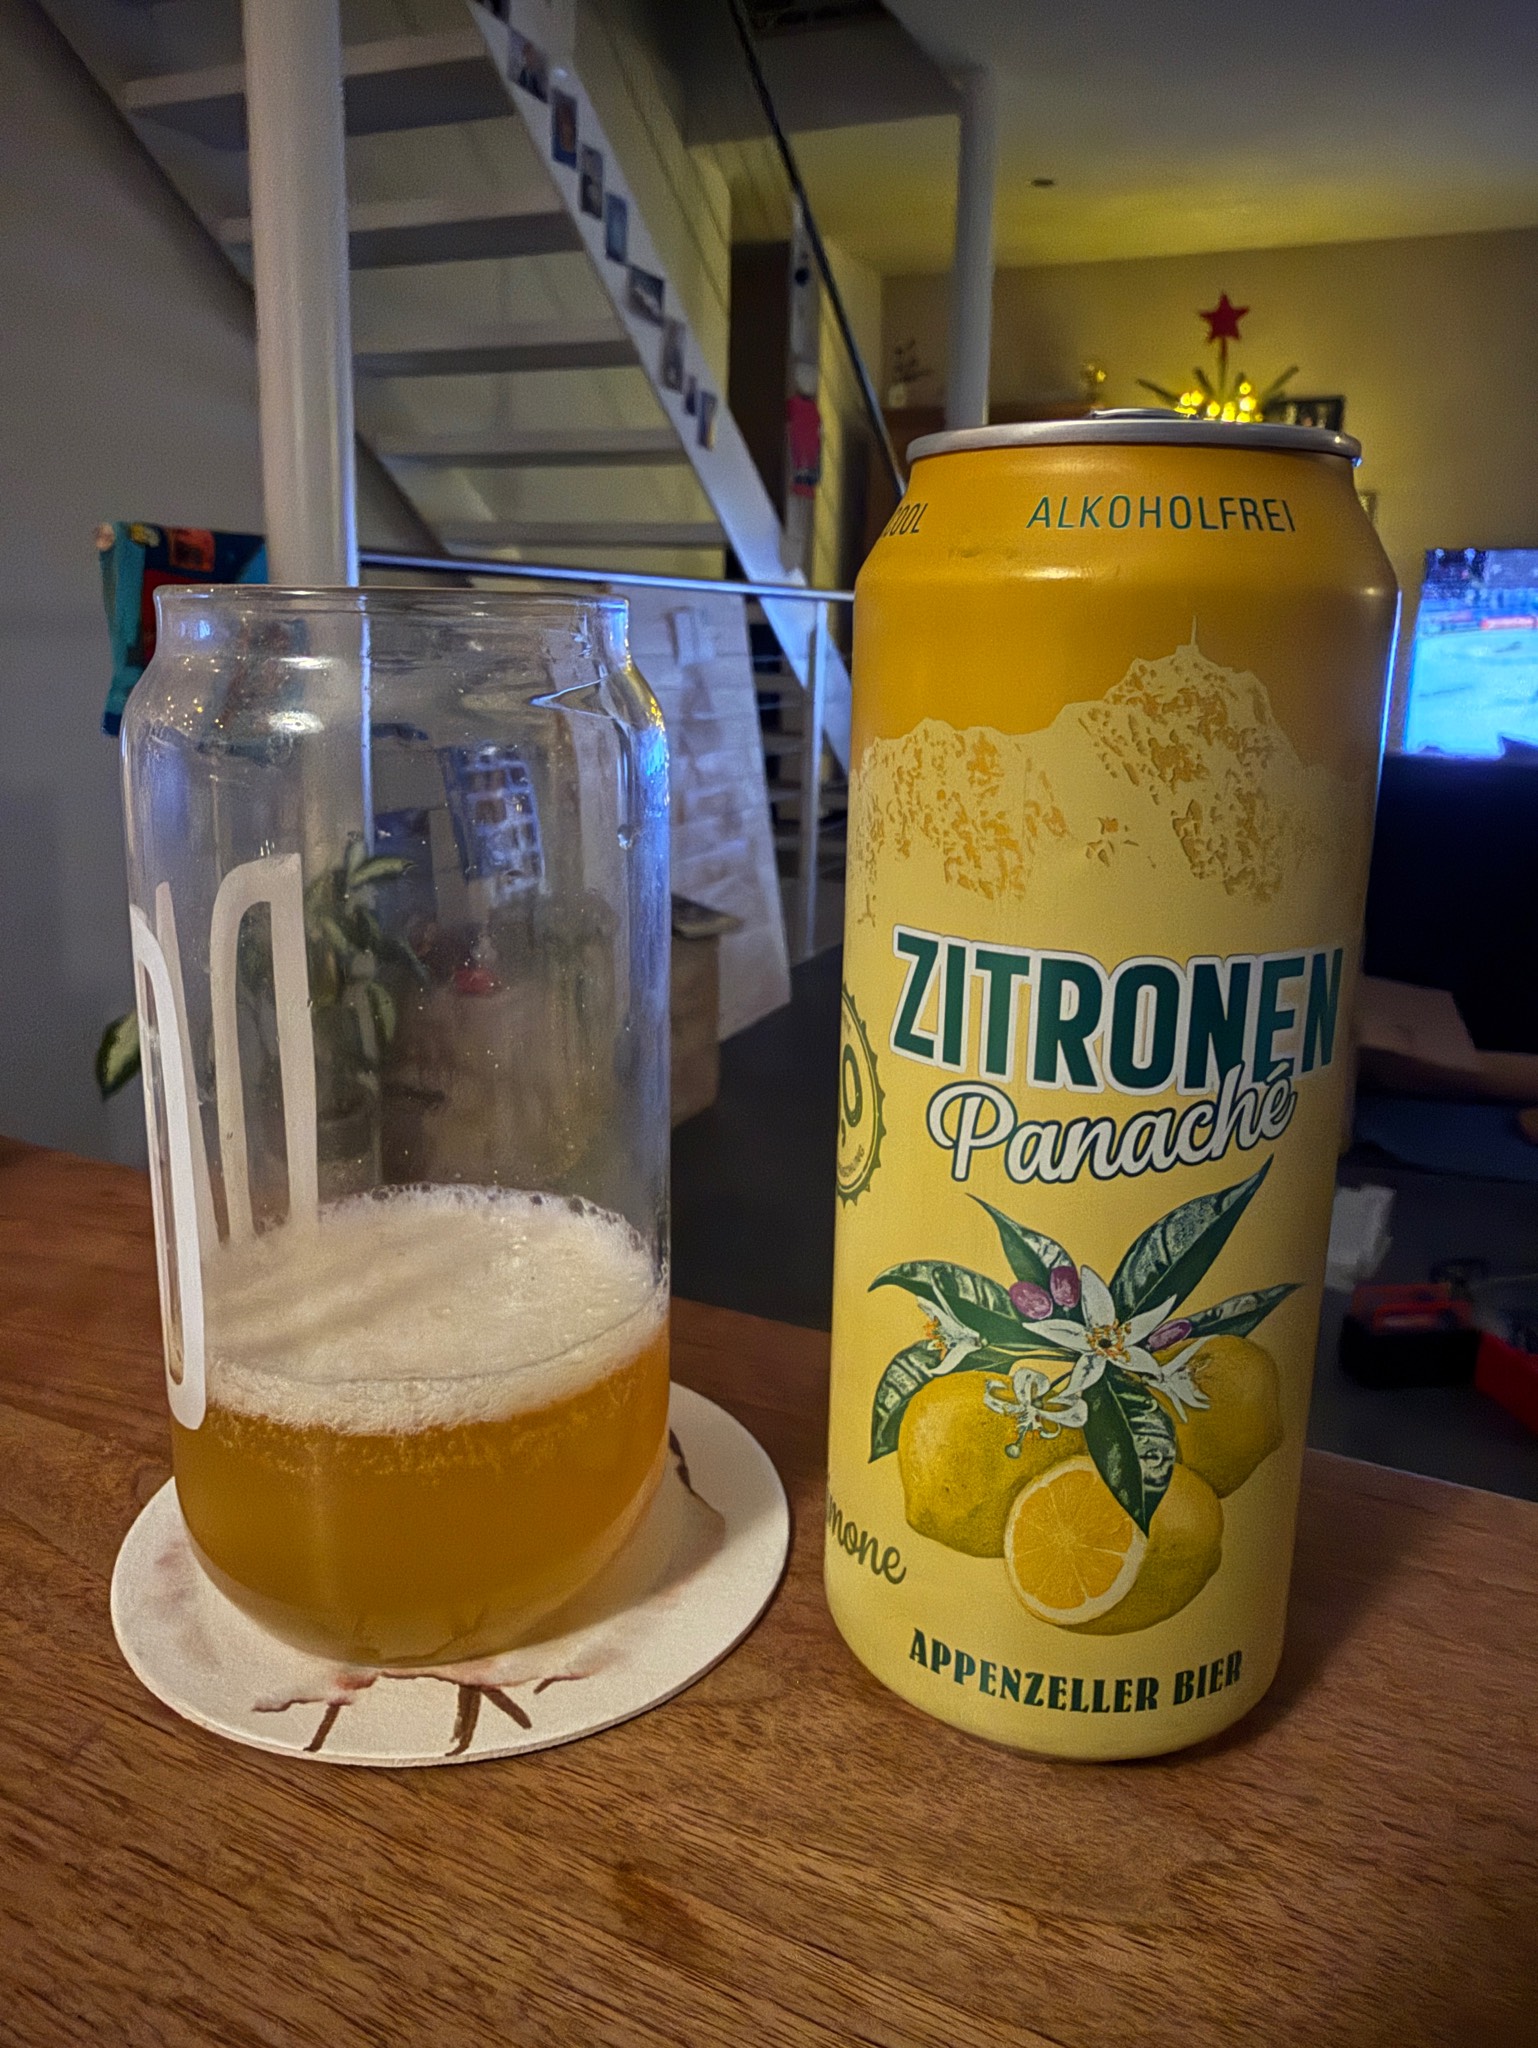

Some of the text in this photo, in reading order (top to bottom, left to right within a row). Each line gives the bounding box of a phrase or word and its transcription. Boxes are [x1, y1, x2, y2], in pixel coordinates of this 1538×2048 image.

[1026, 495, 1297, 533] ALKOHOLFREI
[889, 925, 1345, 1096] ZITRONEN
[926, 1061, 1298, 1185] Panaché
[909, 1628, 1243, 1714] APPENZELLER BIER
